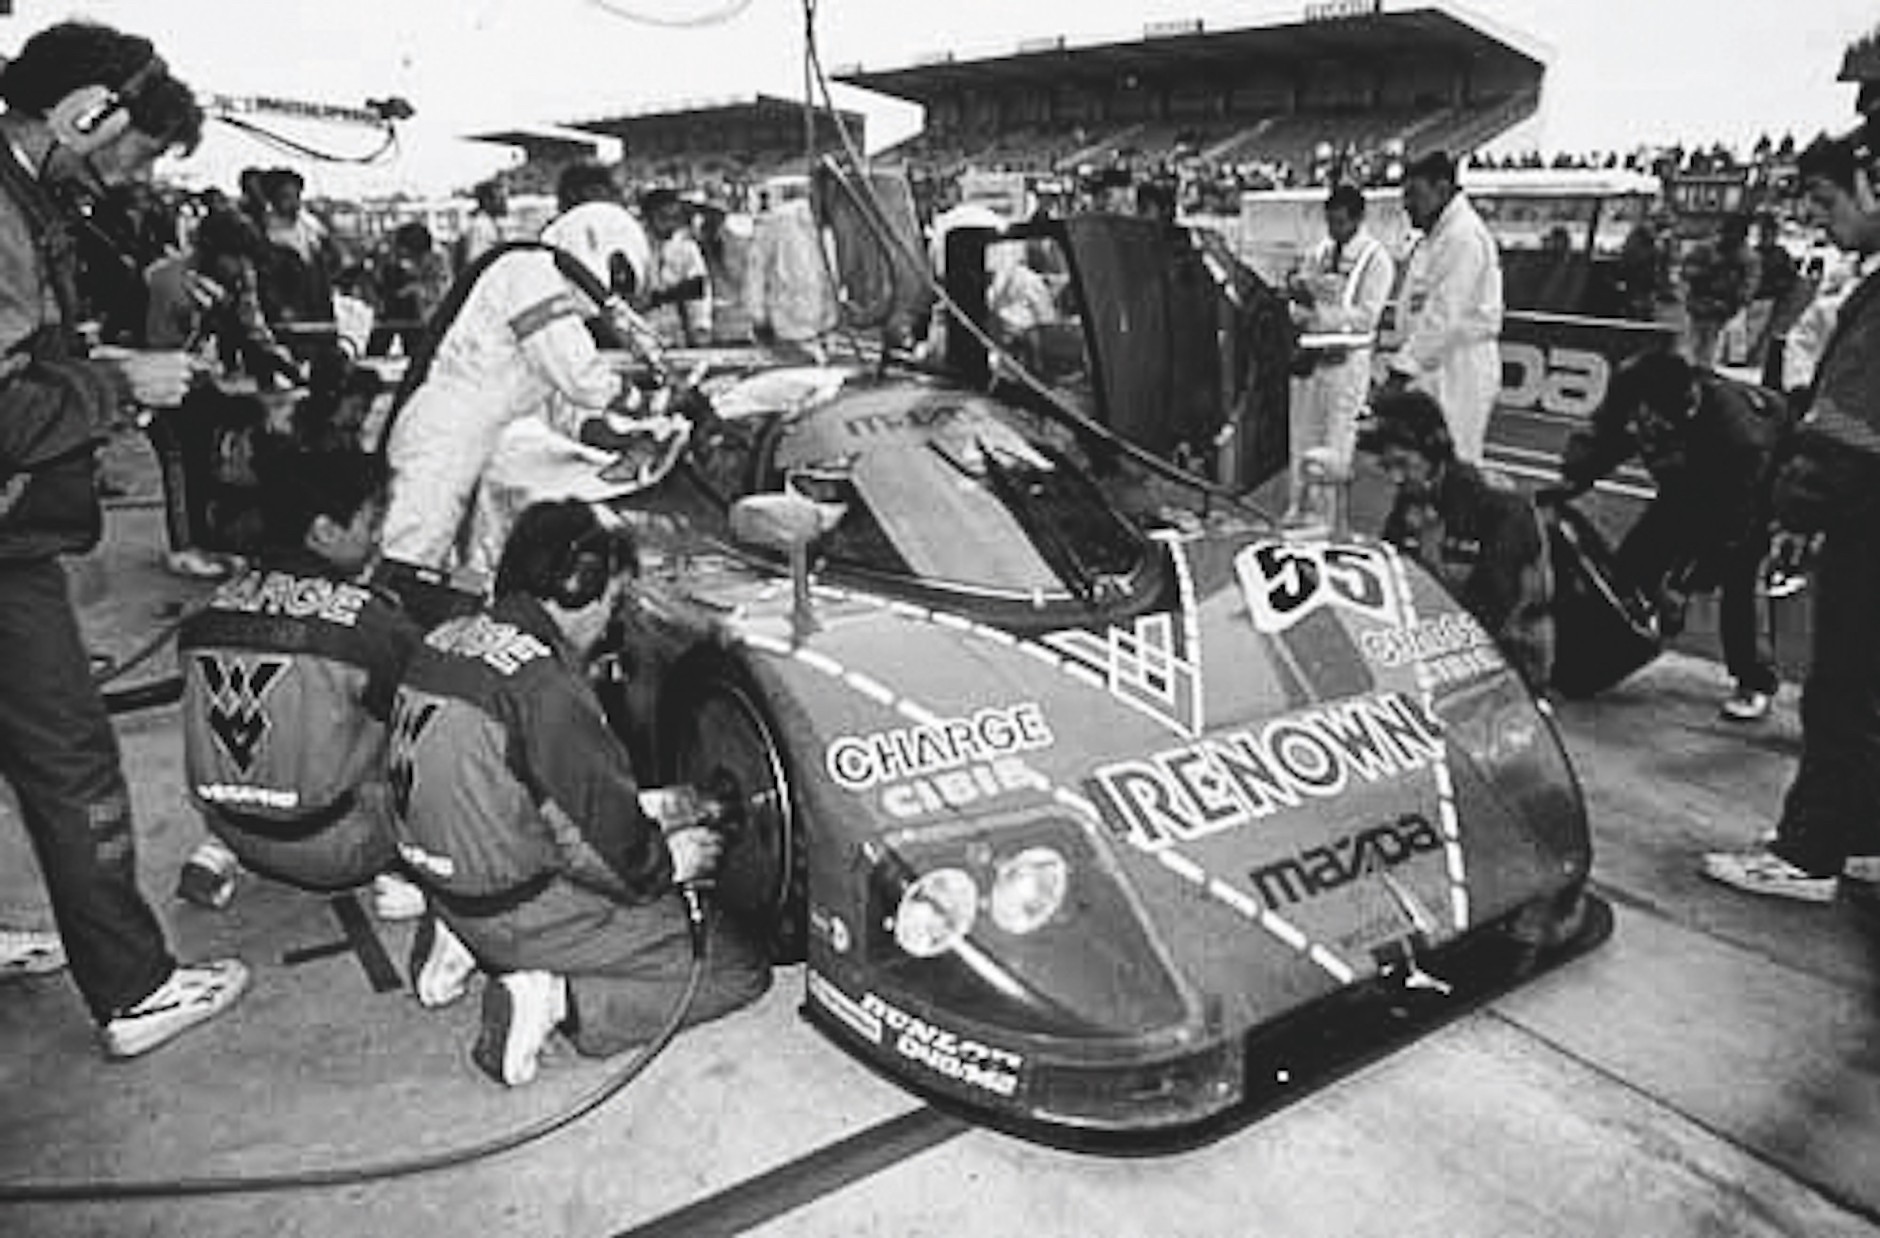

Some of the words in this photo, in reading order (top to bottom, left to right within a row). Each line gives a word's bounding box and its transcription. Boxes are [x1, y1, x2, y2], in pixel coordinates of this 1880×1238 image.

[1253, 545, 1386, 613] 55
[827, 701, 1054, 791] CHARGE
[1090, 692, 1447, 852] RENOWN
[1250, 813, 1442, 911] mazda
